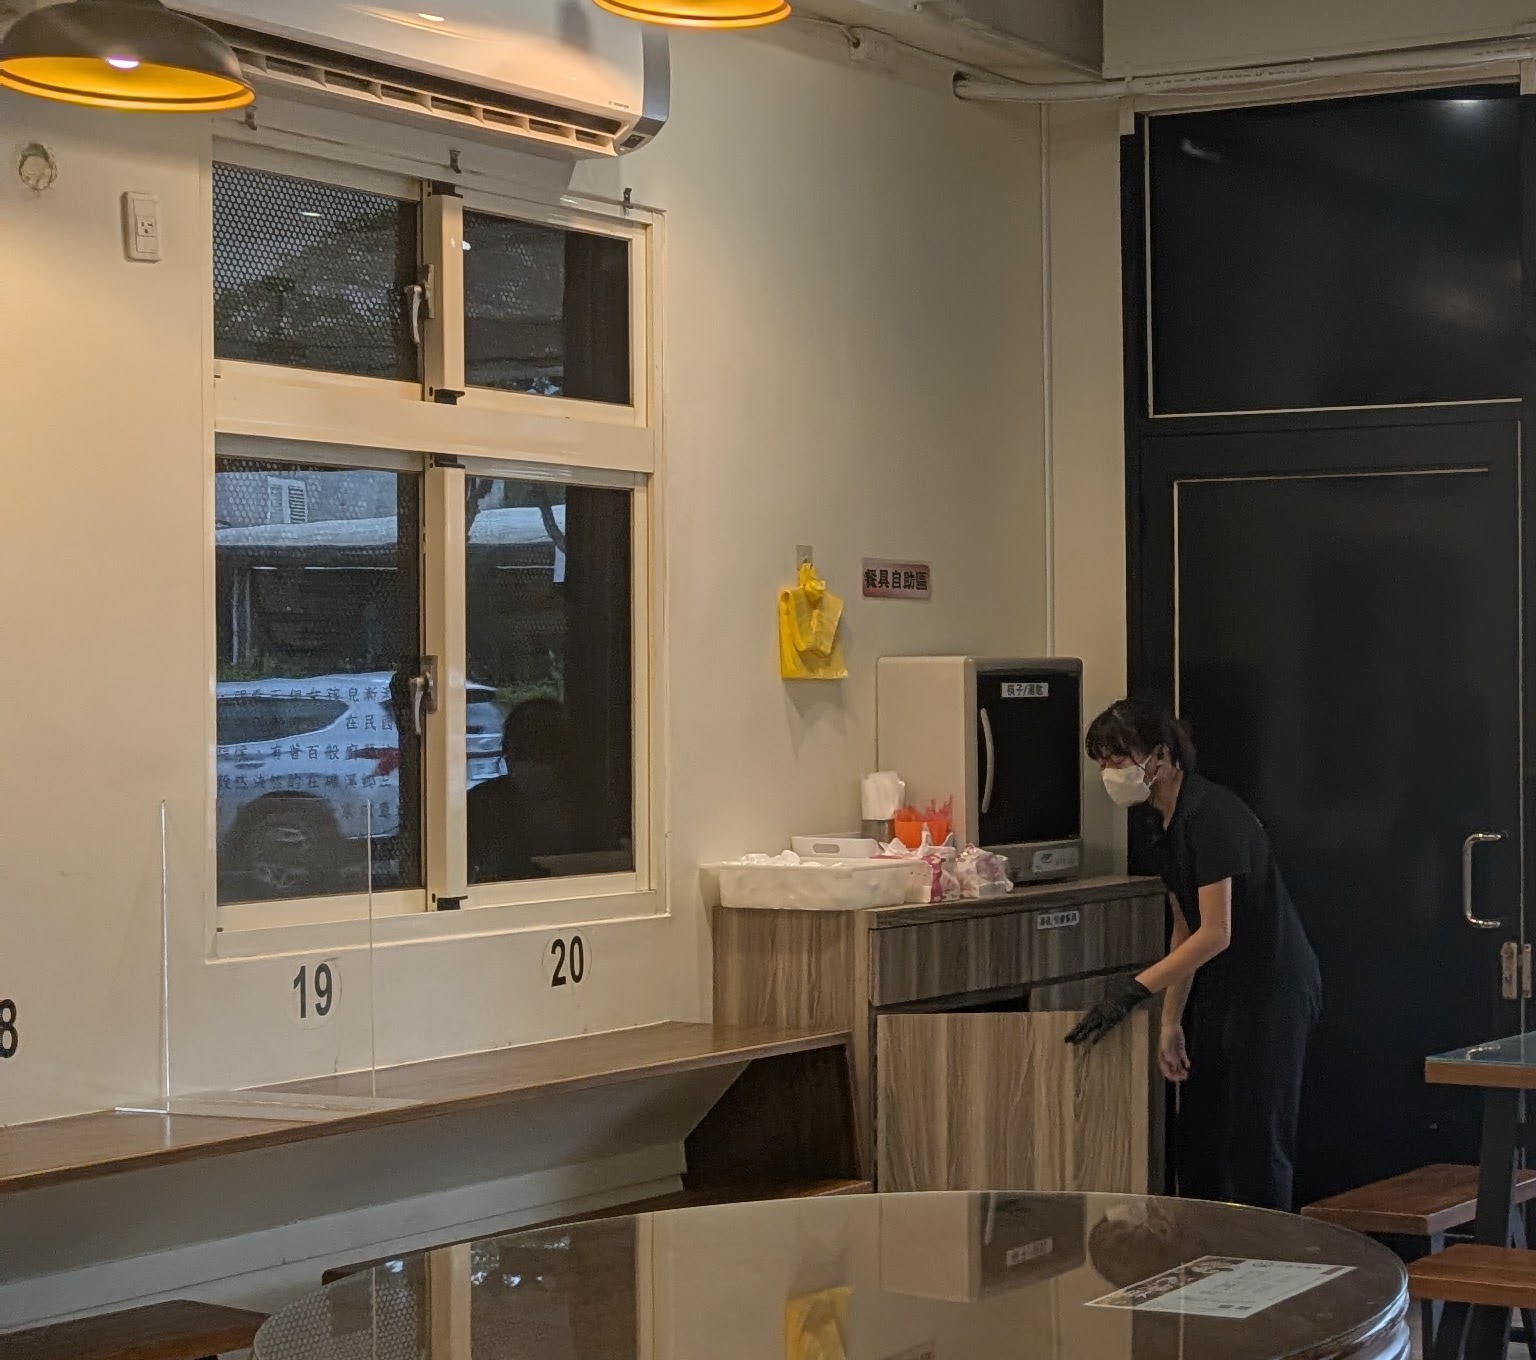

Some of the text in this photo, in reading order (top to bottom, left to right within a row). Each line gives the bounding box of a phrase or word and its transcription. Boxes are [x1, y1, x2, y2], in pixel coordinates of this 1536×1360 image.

[864, 569, 928, 591] 餐具自助區
[550, 935, 585, 988] 20
[292, 962, 334, 1019] 19
